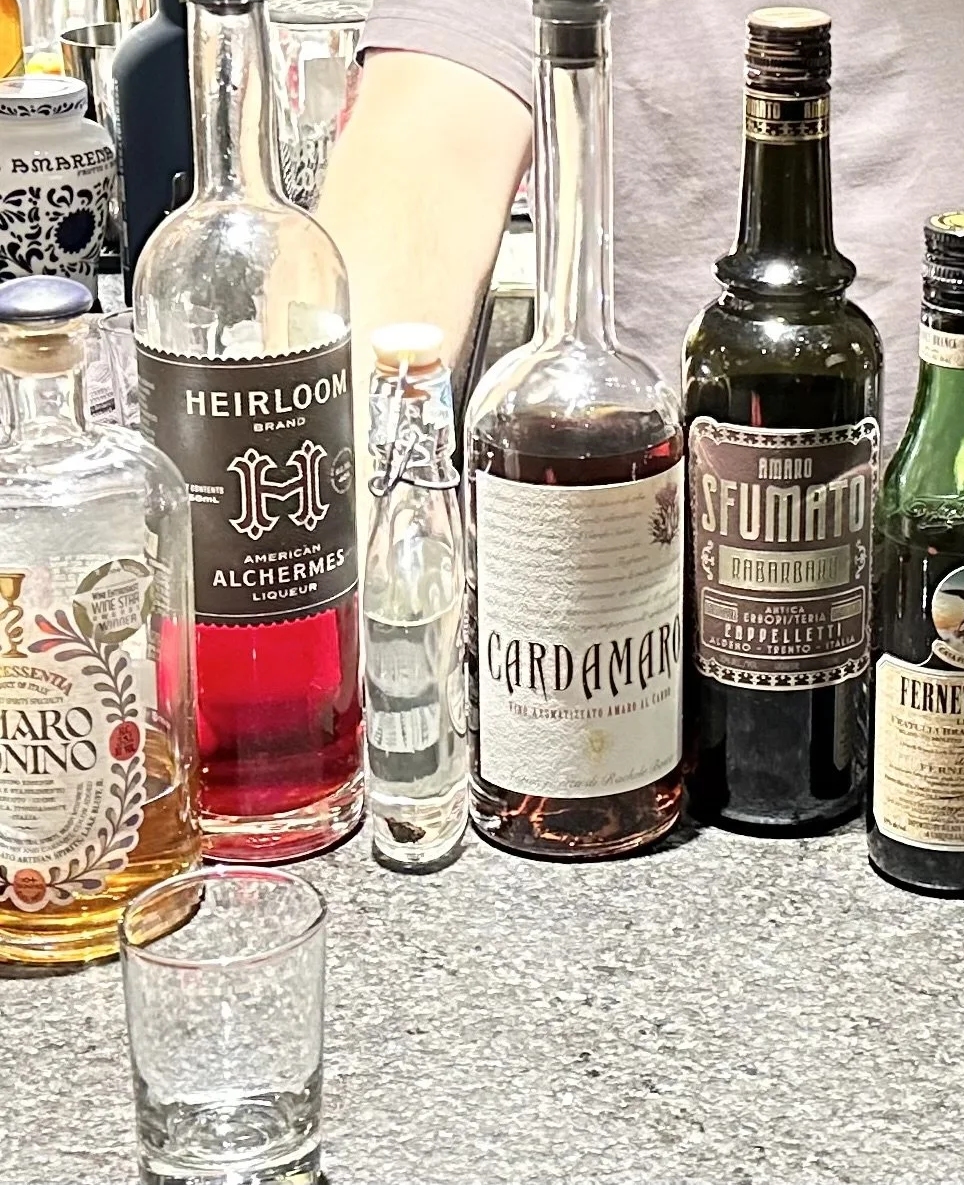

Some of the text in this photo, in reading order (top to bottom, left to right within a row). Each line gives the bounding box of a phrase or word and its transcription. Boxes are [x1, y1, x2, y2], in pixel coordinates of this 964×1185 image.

[185, 368, 348, 417] HEIRLOOM
[253, 416, 306, 433] BRAND
[758, 457, 813, 480] AMARO
[701, 472, 867, 544] SFUMATO
[243, 543, 322, 564] AMERICAN
[212, 548, 346, 588] ALCHERMES
[731, 556, 838, 584] RABARBARO
[252, 582, 318, 602] LIQUEUR
[91, 597, 116, 615] WINE
[765, 605, 805, 615] ANTICA
[98, 614, 137, 632] WINNER
[724, 622, 843, 645] CAPPELLETTI
[709, 634, 856, 656] ALDENO TRENTO ITALIA
[487, 613, 682, 702] CARDAMARO
[608, 700, 637, 717] AMARO
[640, 696, 651, 710] AL
[0, 739, 97, 775] NINO
